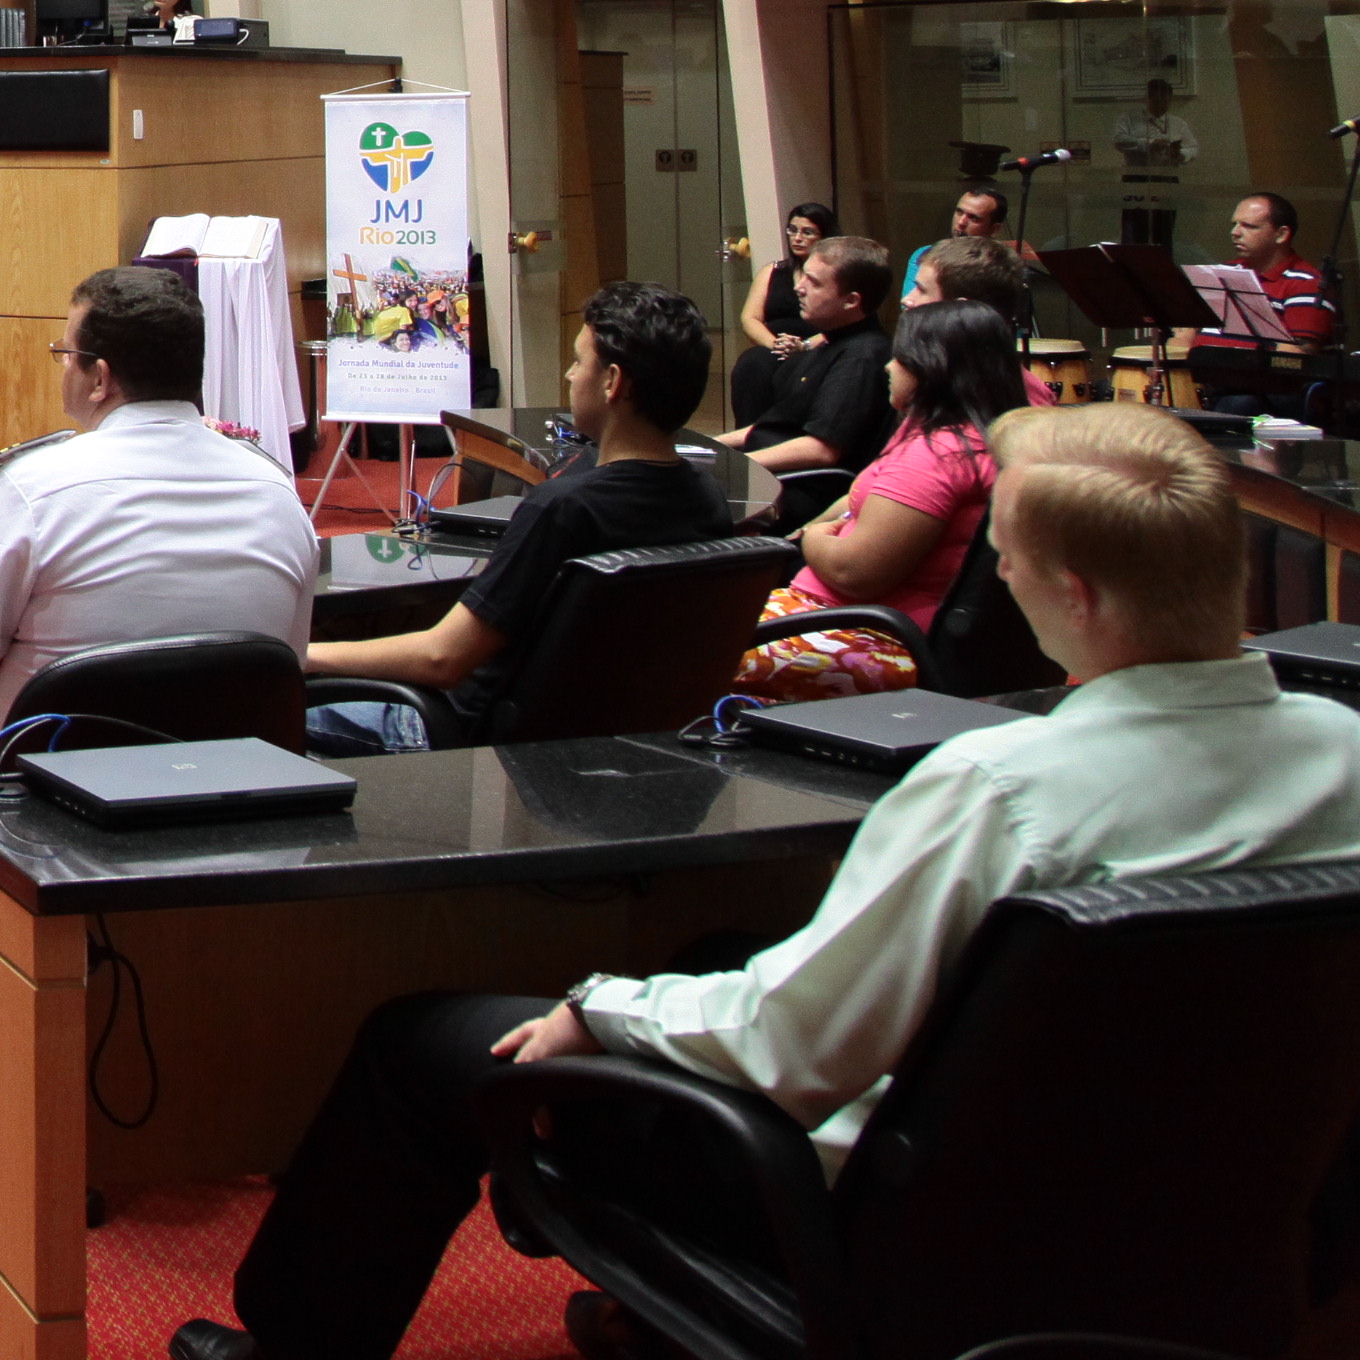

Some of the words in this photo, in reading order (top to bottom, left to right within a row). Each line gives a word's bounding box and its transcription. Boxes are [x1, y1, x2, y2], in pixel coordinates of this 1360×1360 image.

[369, 199, 423, 224] JMJ
[338, 359, 370, 367] Jornada
[372, 359, 404, 368] Mundial
[405, 360, 416, 368] da
[417, 361, 459, 369] Juventude
